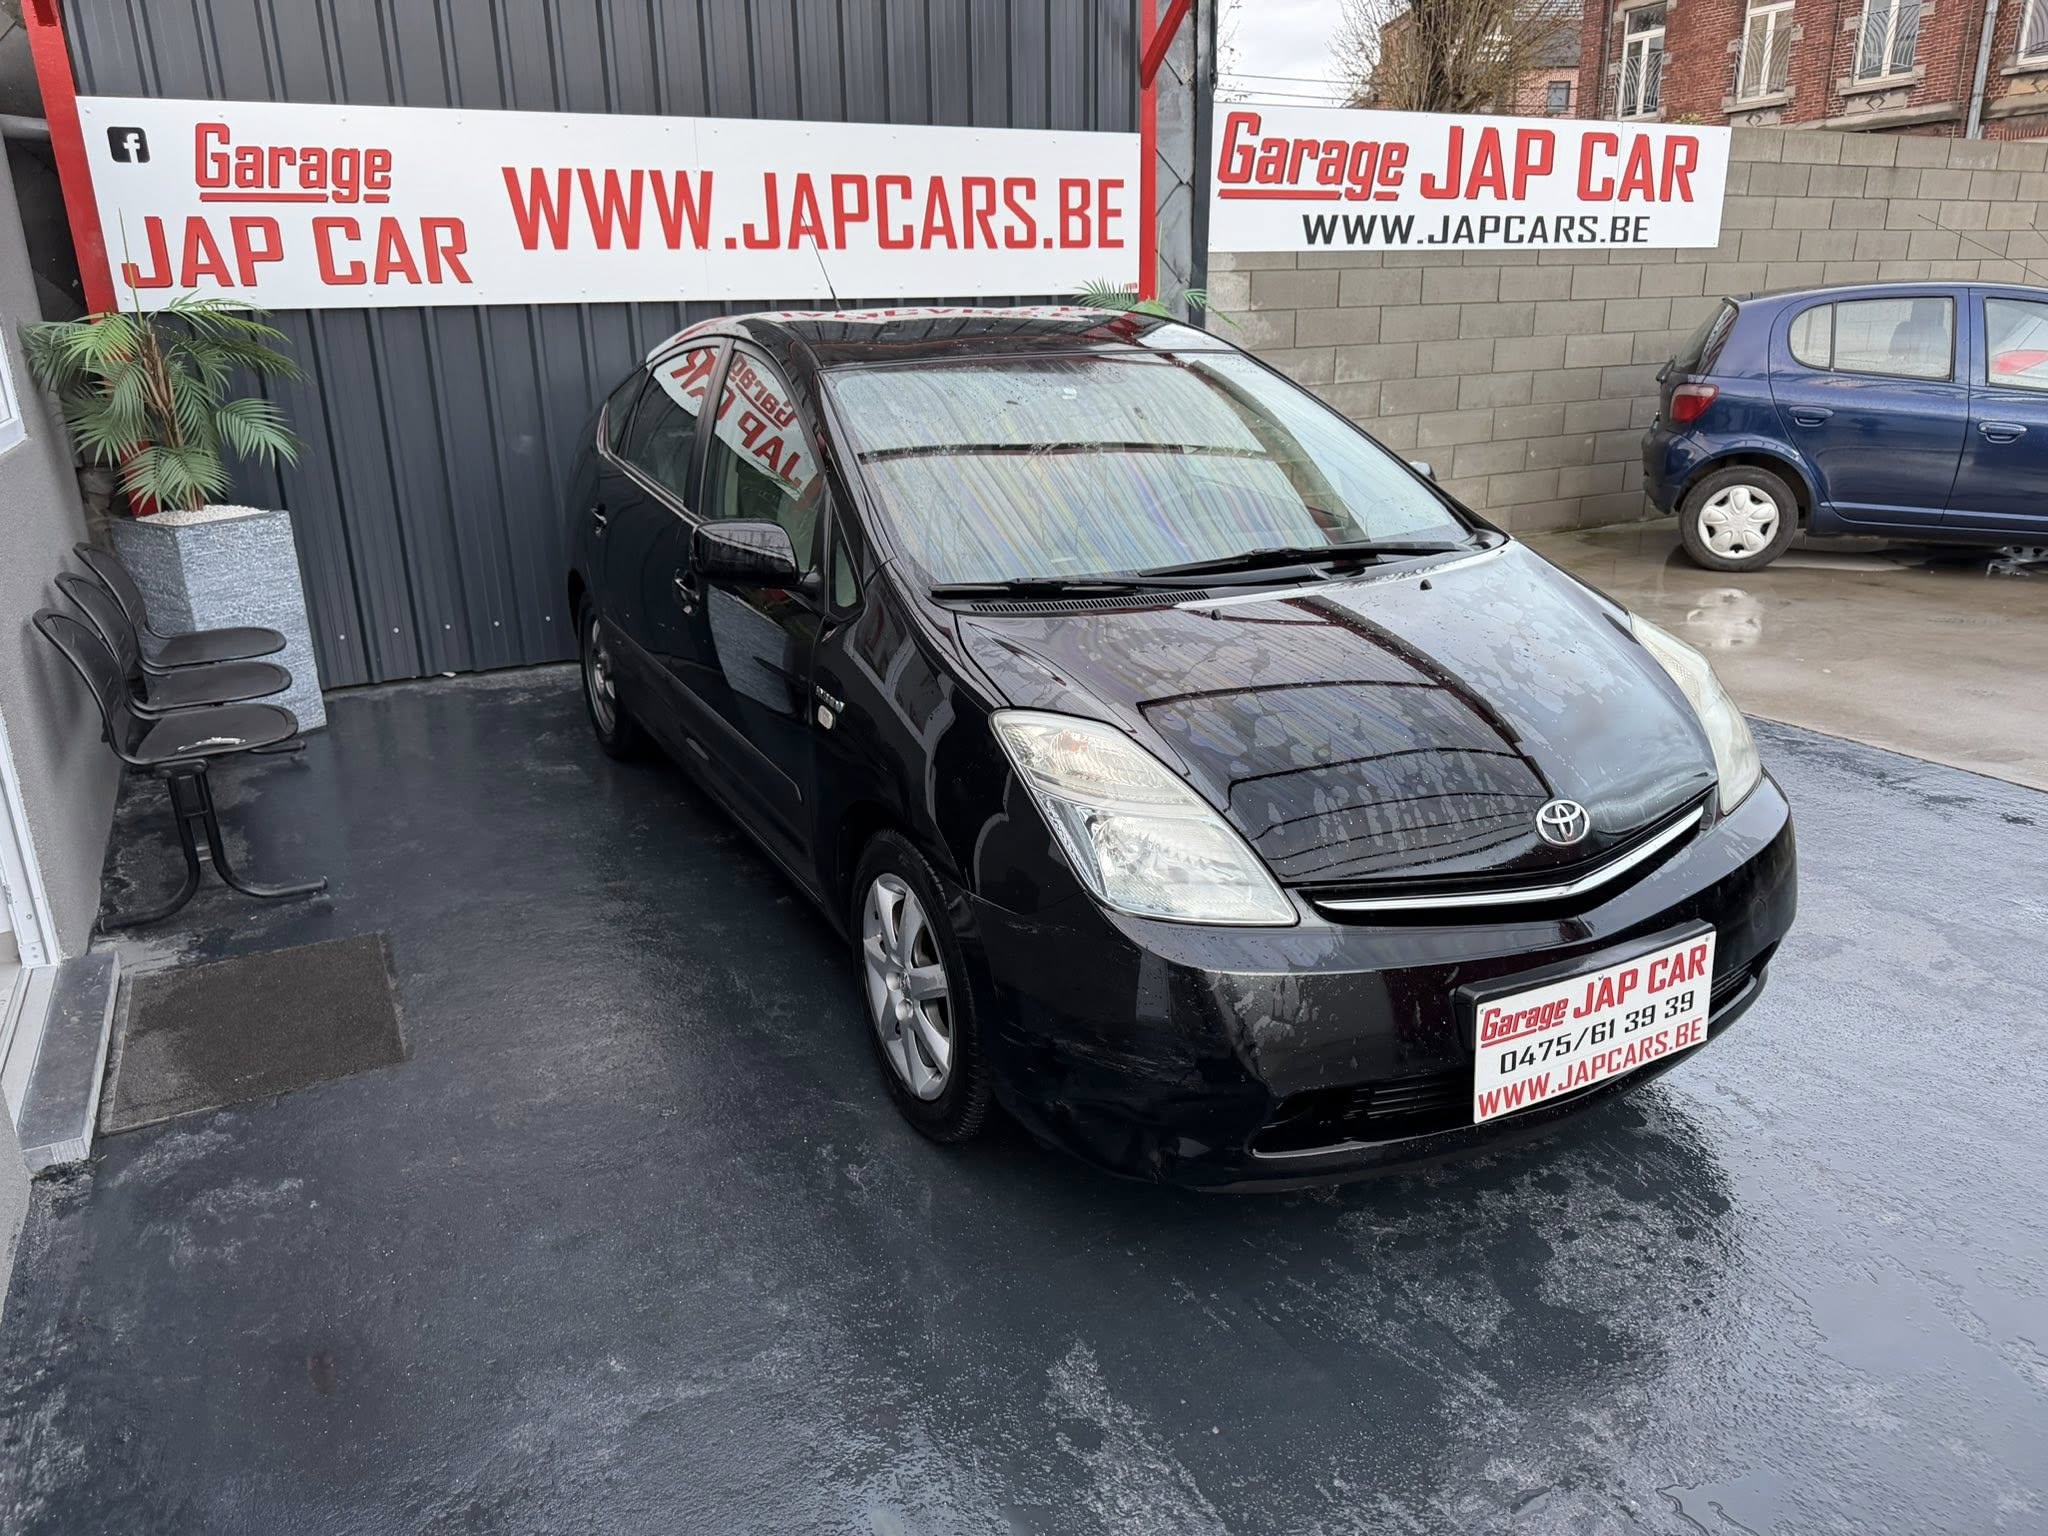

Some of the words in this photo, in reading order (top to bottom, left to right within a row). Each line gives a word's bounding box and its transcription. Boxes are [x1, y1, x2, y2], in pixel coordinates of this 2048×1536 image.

[195, 123, 392, 203] Garage
[1218, 112, 1408, 201] Garage
[1420, 126, 1555, 200] JAP
[1578, 132, 1699, 202] CAR
[502, 167, 1124, 251] WWW.JAPCARS.BE
[1302, 214, 1650, 244] WWW.JAPCARS.BE
[122, 216, 283, 288] JAP
[312, 217, 473, 285] CAR
[1480, 998, 1569, 1044] Garage
[1573, 968, 1639, 1019] JAP
[1647, 943, 1708, 994] CAR
[1500, 1019, 1616, 1074] 0475/61
[1624, 1004, 1656, 1033] 39
[1664, 990, 1695, 1018] 39
[1478, 1017, 1702, 1117] WWW.JAPCARS.BE
